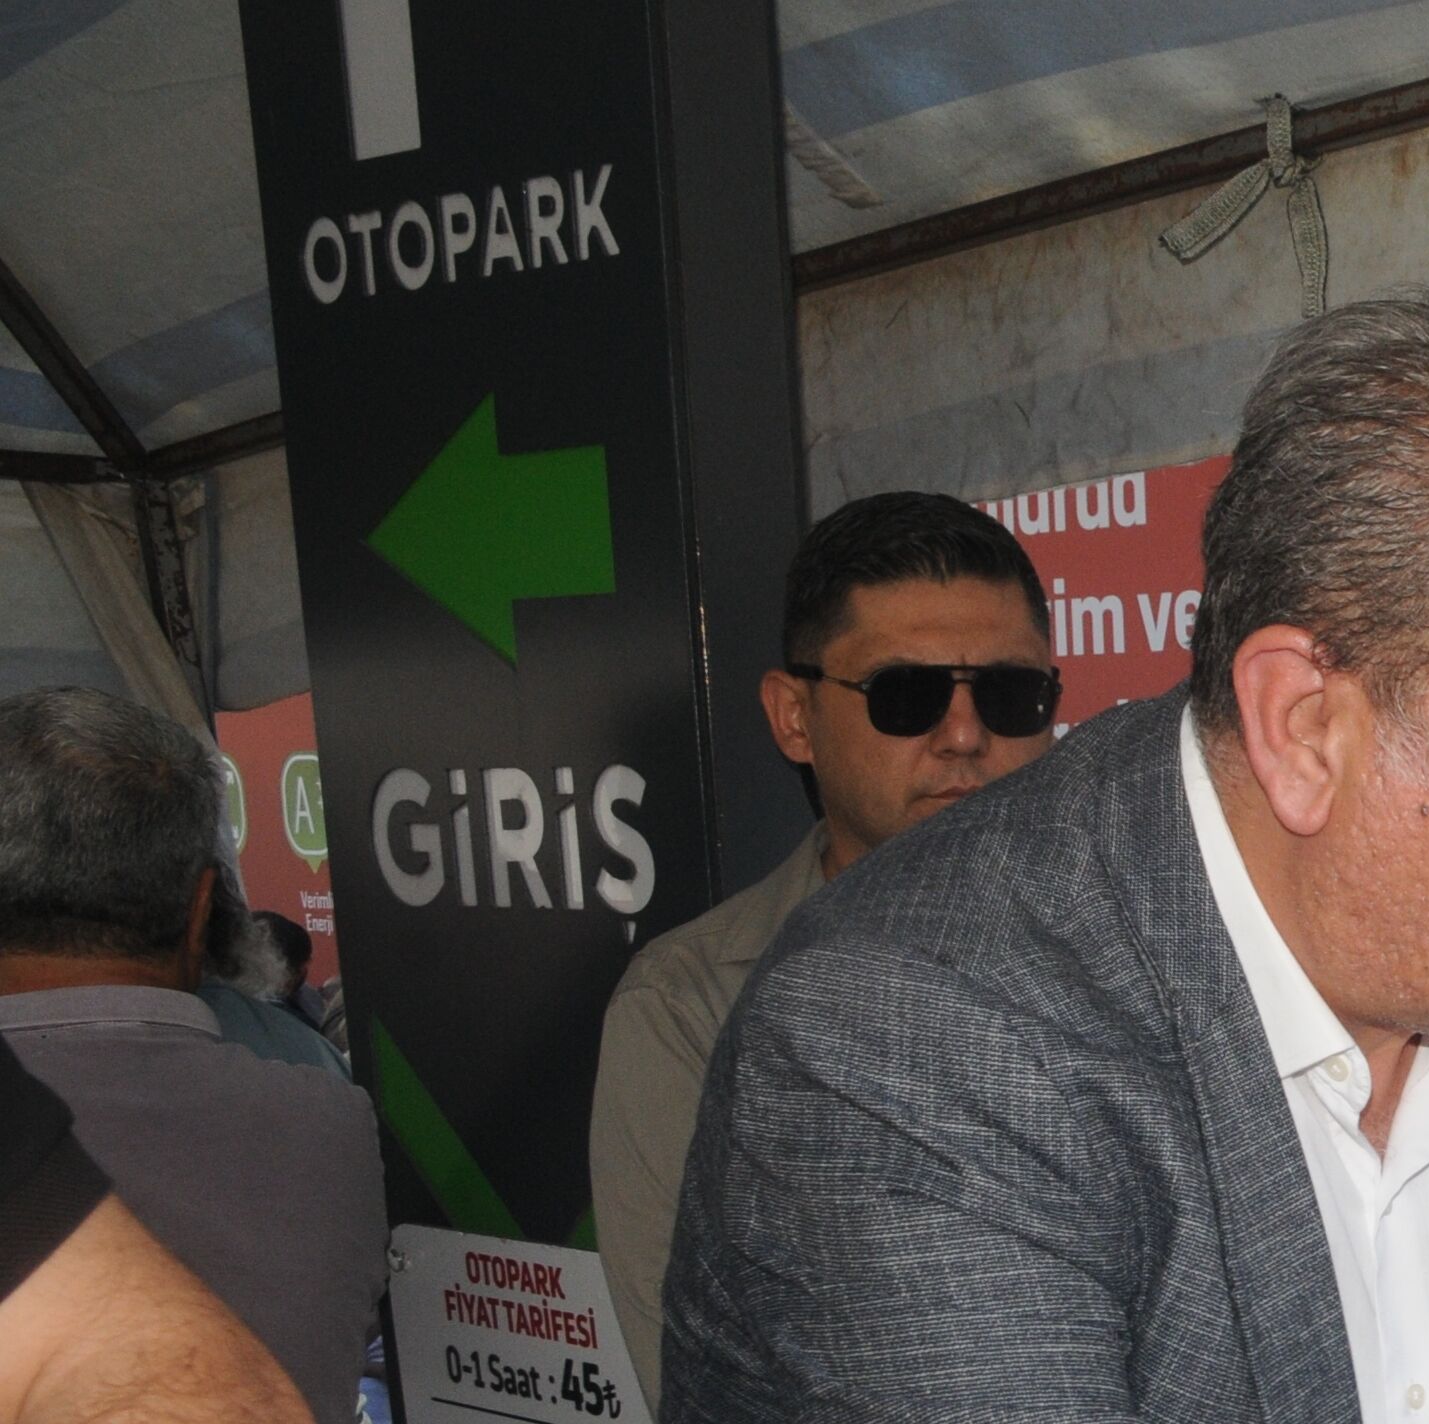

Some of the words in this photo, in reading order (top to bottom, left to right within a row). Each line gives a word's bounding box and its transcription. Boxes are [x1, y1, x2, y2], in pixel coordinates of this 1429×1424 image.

[303, 163, 620, 305] OTOPARK
[465, 1251, 567, 1300] OTOPARK
[444, 1282, 500, 1330] FİYAT
[501, 1298, 598, 1349] TARİFESİ
[446, 1345, 485, 1388] 0-1
[487, 1354, 543, 1402] Saat
